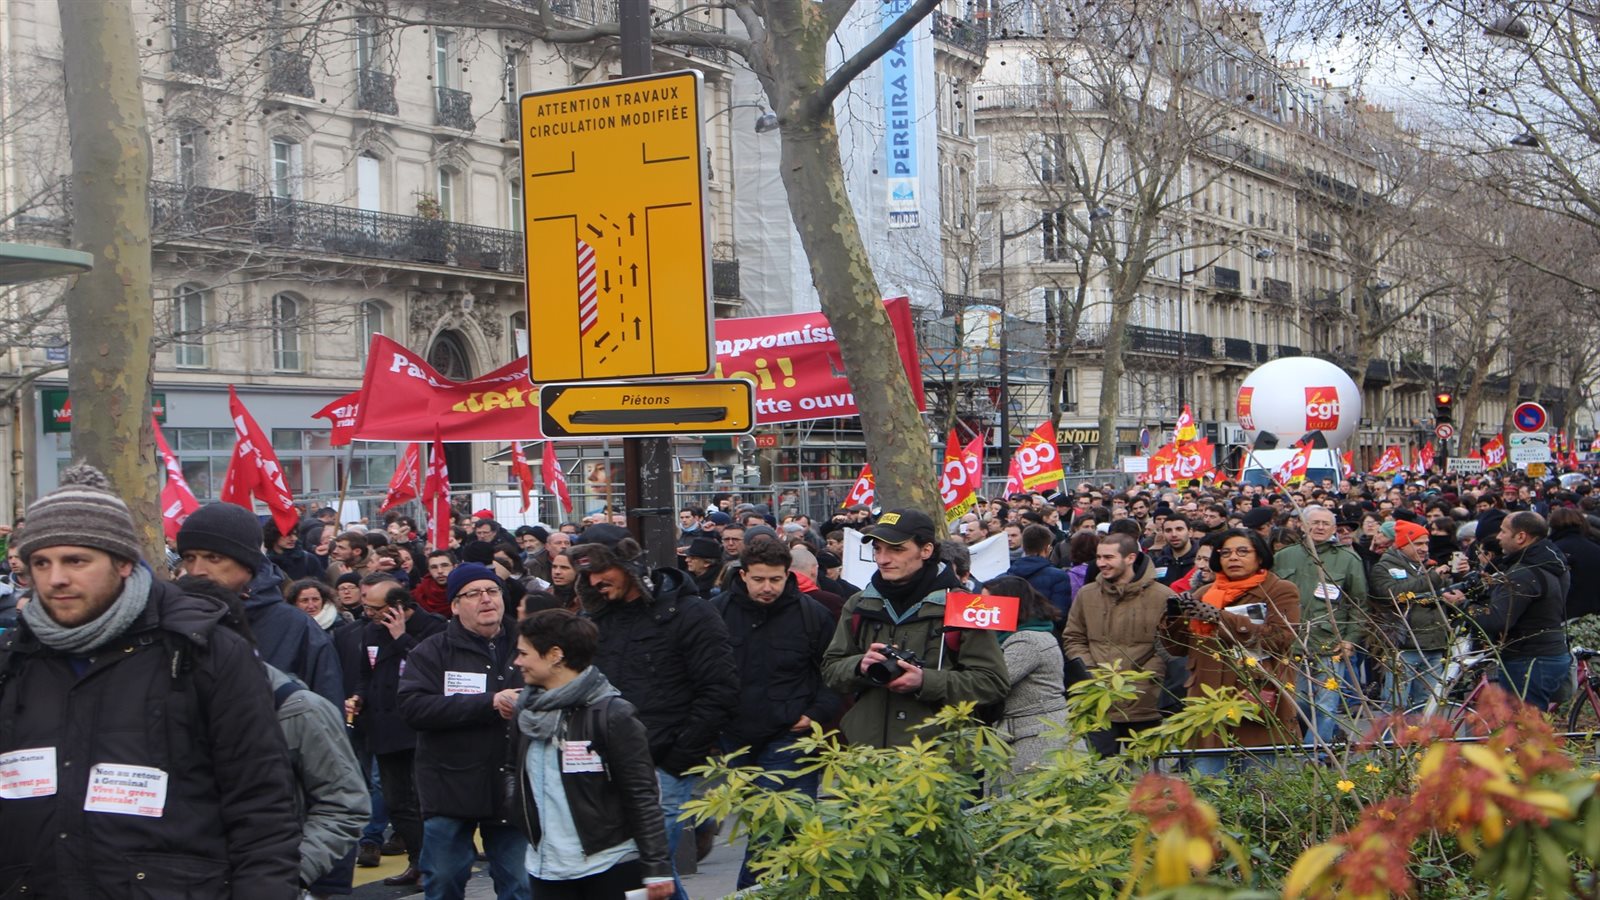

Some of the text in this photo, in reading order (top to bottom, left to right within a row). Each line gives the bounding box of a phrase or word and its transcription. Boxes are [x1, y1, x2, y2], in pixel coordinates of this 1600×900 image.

[537, 86, 679, 118] ATTENTION TRAVAUX
[530, 105, 689, 139] CIRCULATION MODIFIÉE
[891, 74, 910, 175] PEREIRA
[621, 394, 671, 406] Piétons
[756, 393, 855, 415] tte ouvr
[53, 408, 72, 418] MA
[1306, 400, 1341, 420] cgt
[1056, 428, 1100, 444] ENDID
[963, 606, 1001, 627] cgt
[95, 768, 115, 776] Non
[131, 772, 162, 781] retour
[101, 777, 148, 788] Germinal
[92, 785, 113, 793] Vive
[128, 789, 158, 798] grève
